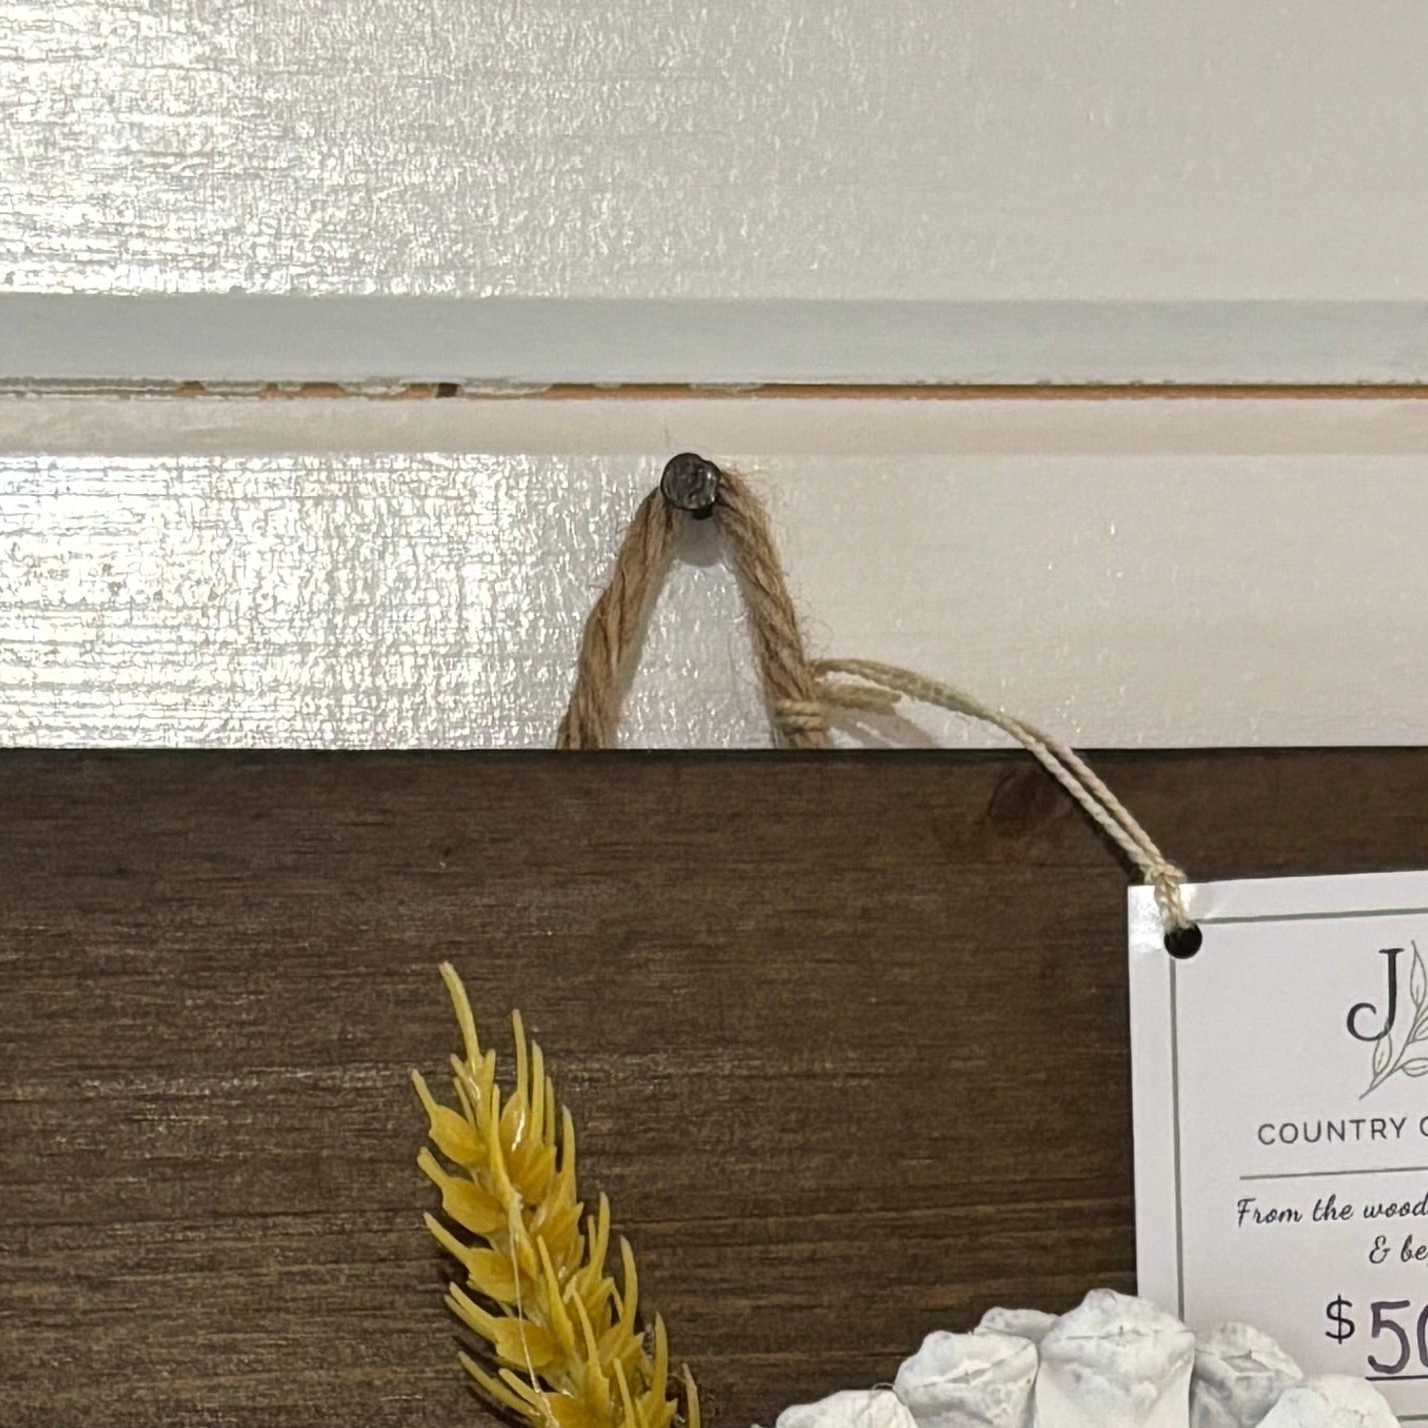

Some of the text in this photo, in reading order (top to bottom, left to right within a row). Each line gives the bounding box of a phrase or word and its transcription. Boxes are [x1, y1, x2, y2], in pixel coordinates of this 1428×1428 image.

[1258, 1117, 1405, 1146] COUNTRY
[1236, 1196, 1303, 1228] From
[1312, 1191, 1354, 1222] the
[1368, 1235, 1391, 1264] &
